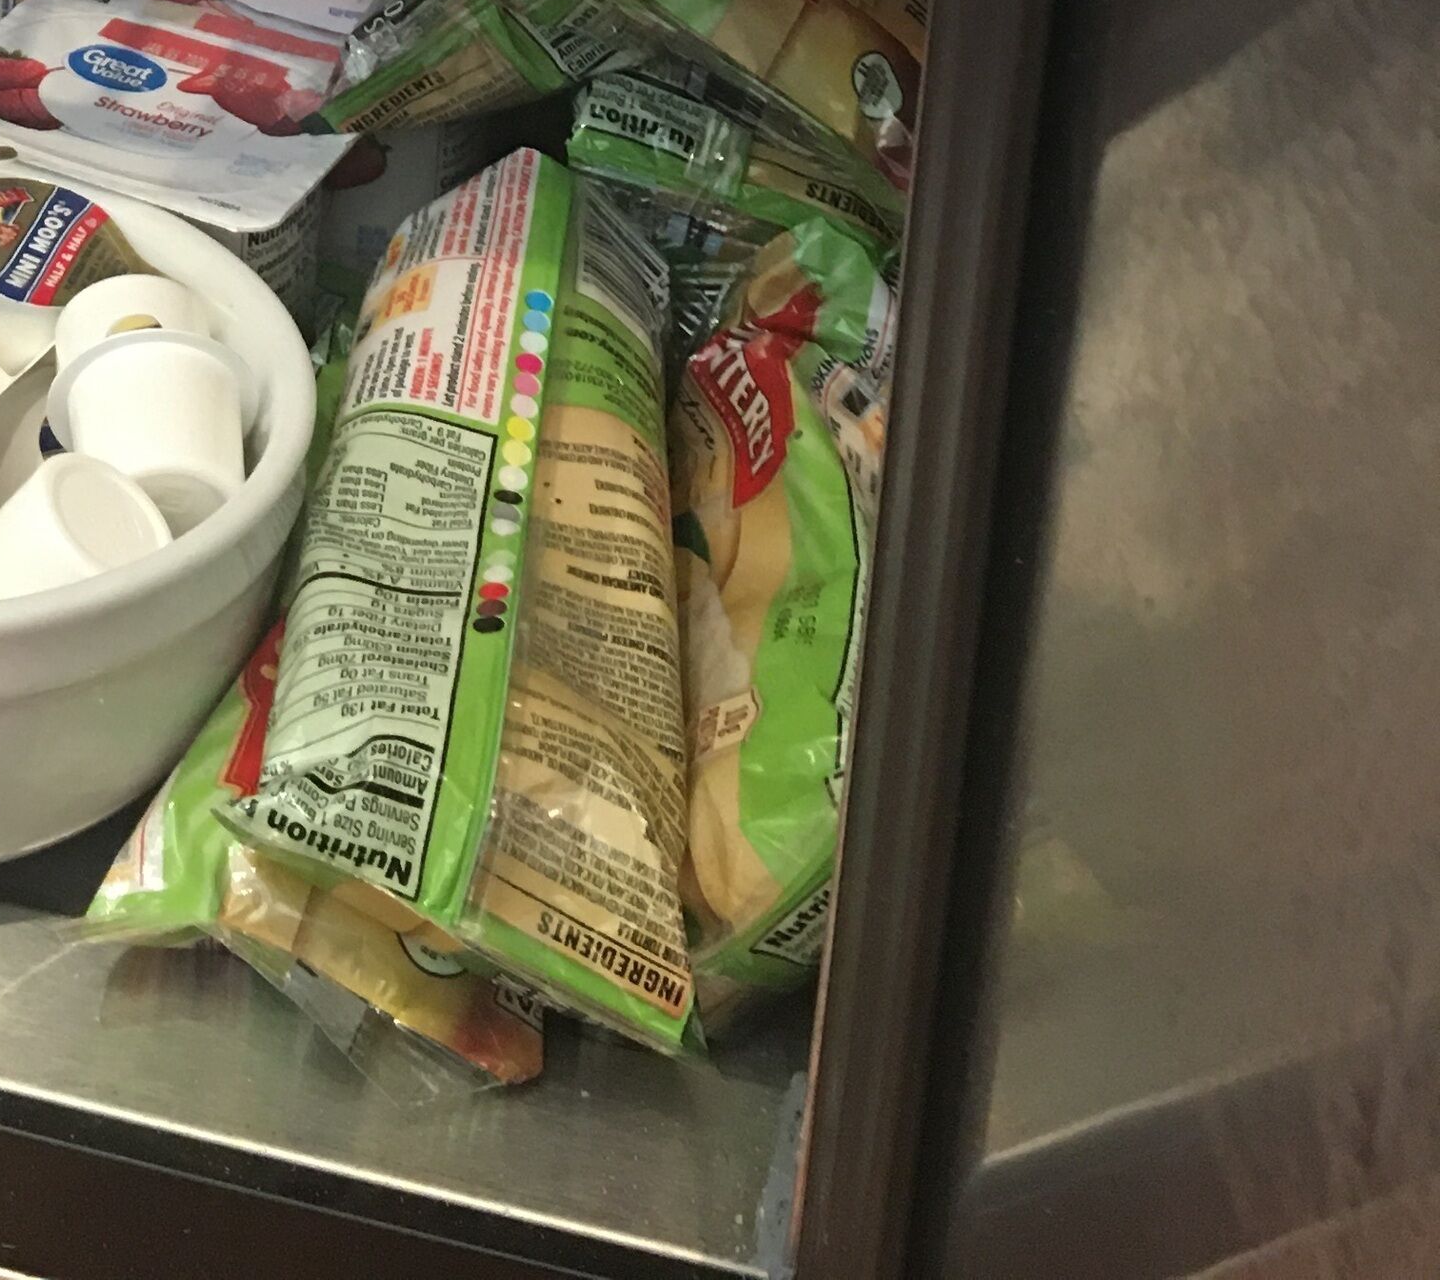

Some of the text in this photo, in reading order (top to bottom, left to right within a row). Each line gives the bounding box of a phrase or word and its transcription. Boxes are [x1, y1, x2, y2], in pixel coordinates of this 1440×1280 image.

[82, 49, 153, 79] Great
[91, 64, 143, 87] Value
[94, 96, 213, 139] Strawberry
[5, 201, 72, 288] MINI MOO'S
[45, 226, 87, 288] HALF HALF
[482, 167, 533, 418] ovens PRODUCT
[426, 353, 443, 389] SECONDS
[442, 335, 465, 407] Let product stand 2
[464, 372, 482, 408] For food
[342, 465, 388, 482] Less than
[447, 459, 481, 476] Protein
[336, 499, 383, 513] Less than
[374, 588, 461, 608] Protein 10g
[411, 578, 464, 590] Vitamin
[327, 606, 442, 633] Dietary Fiber 1g
[314, 625, 452, 646] Total Carbohydrate
[318, 652, 449, 673] Cholesterol 70mg
[396, 645, 451, 660] Sodium
[340, 669, 428, 685] Trans Fat 0g
[313, 685, 427, 706] Saturated 5g
[341, 701, 441, 721] Total Fat 13g
[371, 742, 433, 773] Calories
[372, 763, 429, 795] Amount
[362, 802, 421, 832] Servings
[266, 809, 413, 886] Nutrition
[334, 817, 417, 856] Serving Size
[537, 911, 685, 1007] INGREDIENTS
